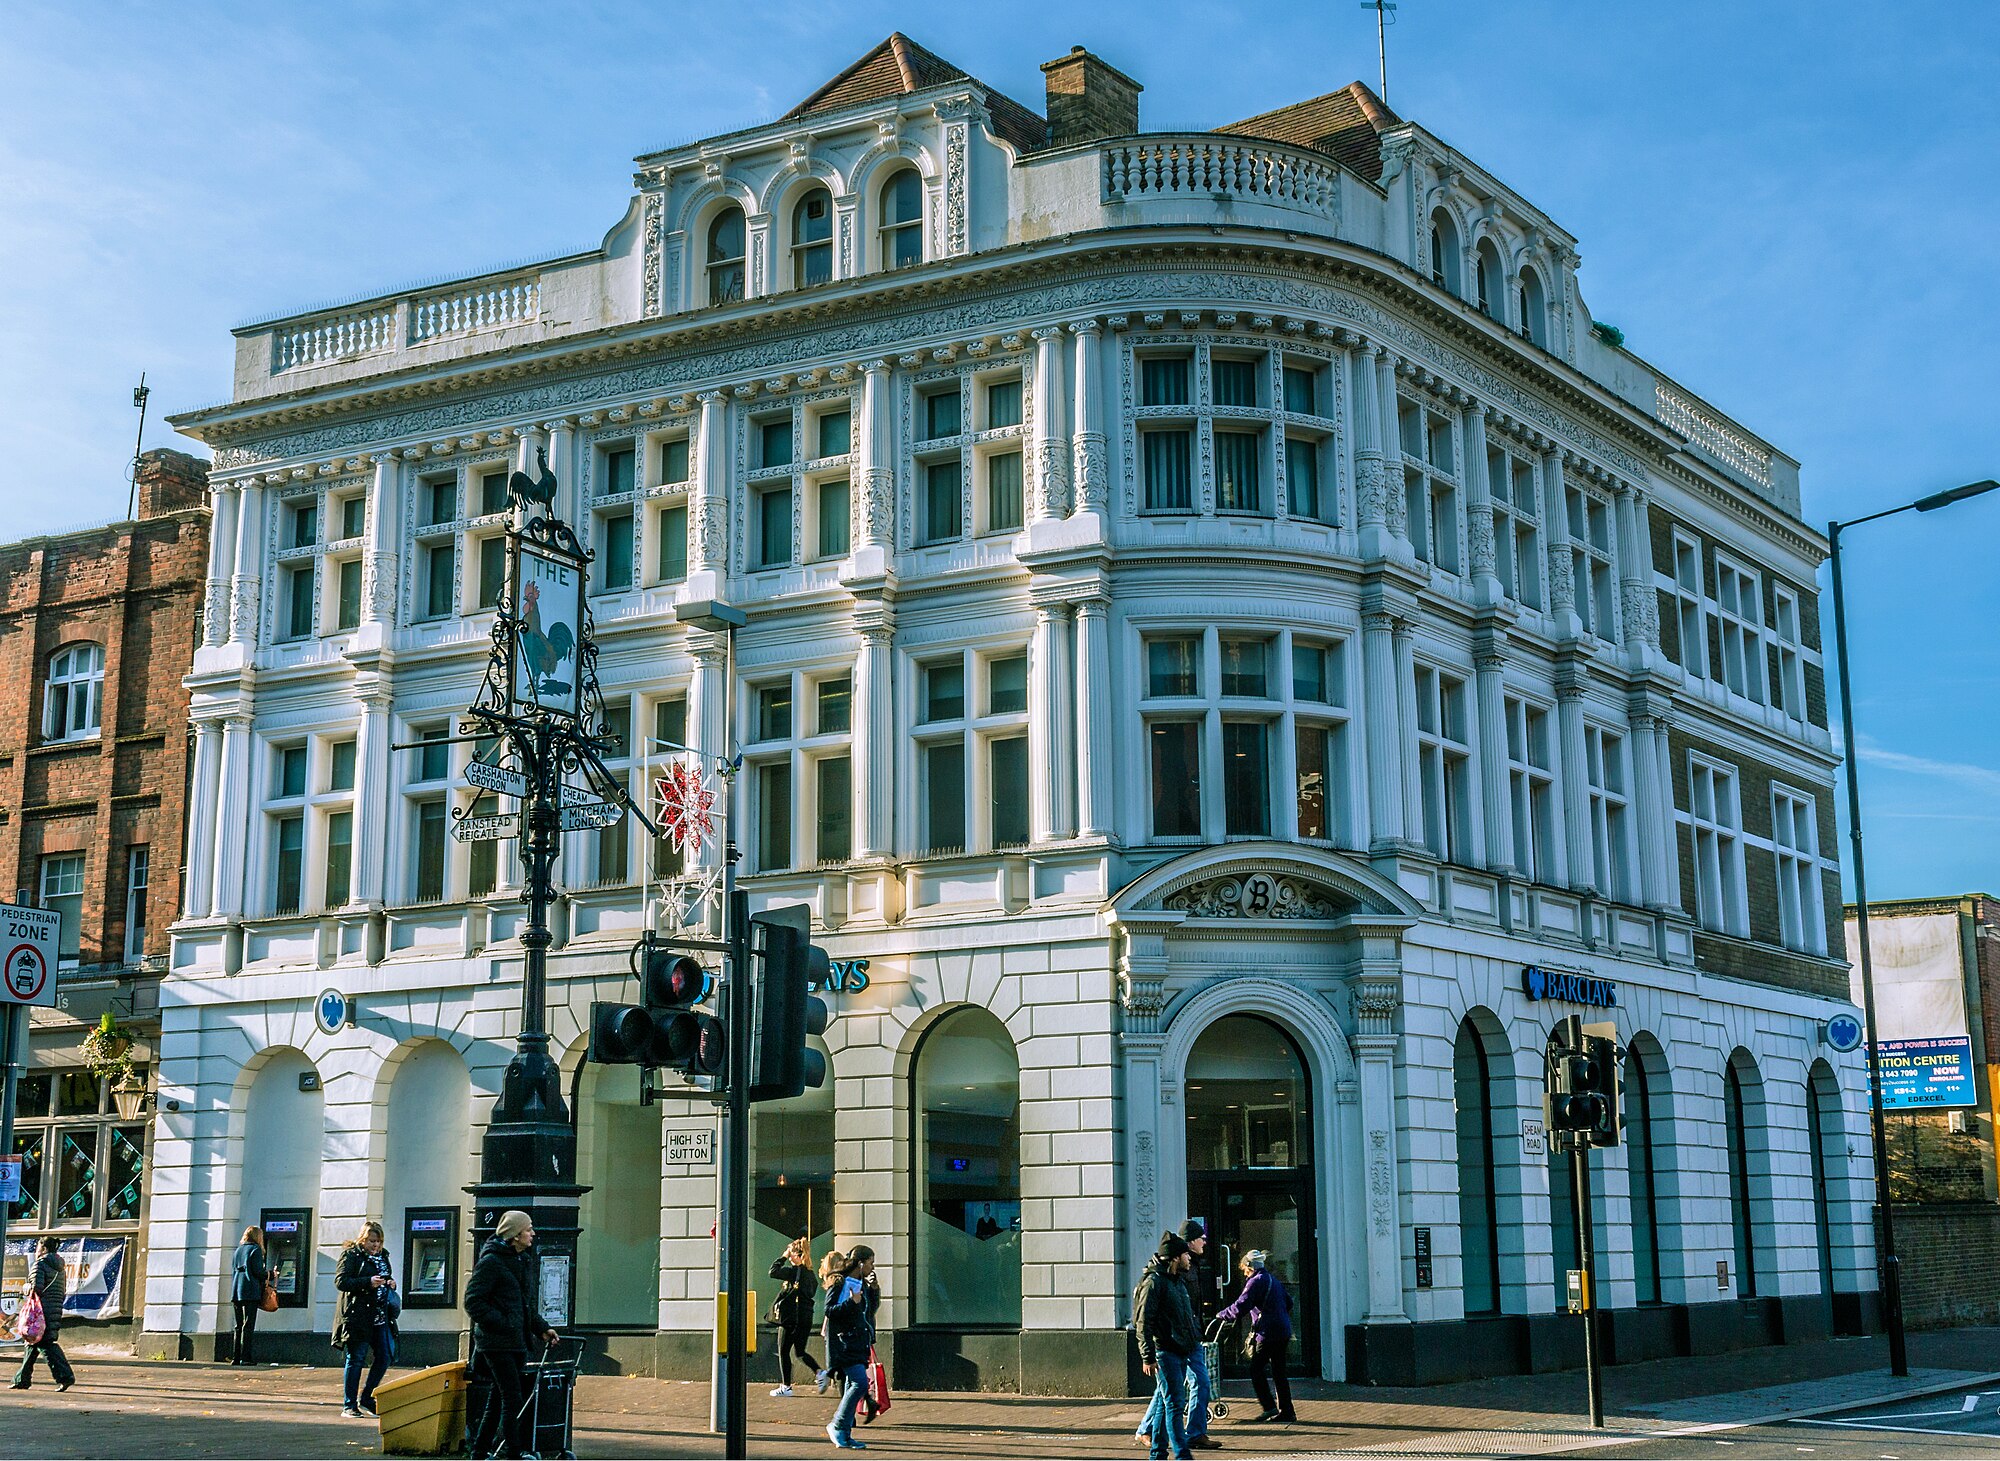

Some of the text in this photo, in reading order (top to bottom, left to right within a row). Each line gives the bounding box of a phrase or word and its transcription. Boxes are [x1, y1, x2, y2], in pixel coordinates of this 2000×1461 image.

[534, 557, 569, 586] THE
[471, 763, 521, 785] CARSHALTON
[471, 773, 506, 791] CROYDON
[563, 788, 588, 803] CHEAM
[569, 804, 615, 818] MITCHAM
[459, 817, 511, 831] BANSTEAD
[569, 815, 609, 828] LONDON
[459, 828, 499, 841] REIGATE
[1, 908, 58, 925] PEDESTRIAN
[8, 923, 49, 941] ZONE
[1548, 971, 1617, 1008] BARCLAYS
[1905, 1041, 1930, 1049] POWER
[1938, 1038, 1968, 1047] SUCCESS
[1865, 1054, 1960, 1068] TITION CENTRE
[1900, 1069, 1918, 1077] 7090
[1932, 1066, 1960, 1075] NOW
[1908, 1095, 1946, 1103] EDEXCEL
[1525, 1125, 1542, 1135] CHEAM
[670, 1135, 692, 1145] HIGH
[1527, 1139, 1541, 1149] ROAD
[670, 1148, 708, 1159] SUTTON
